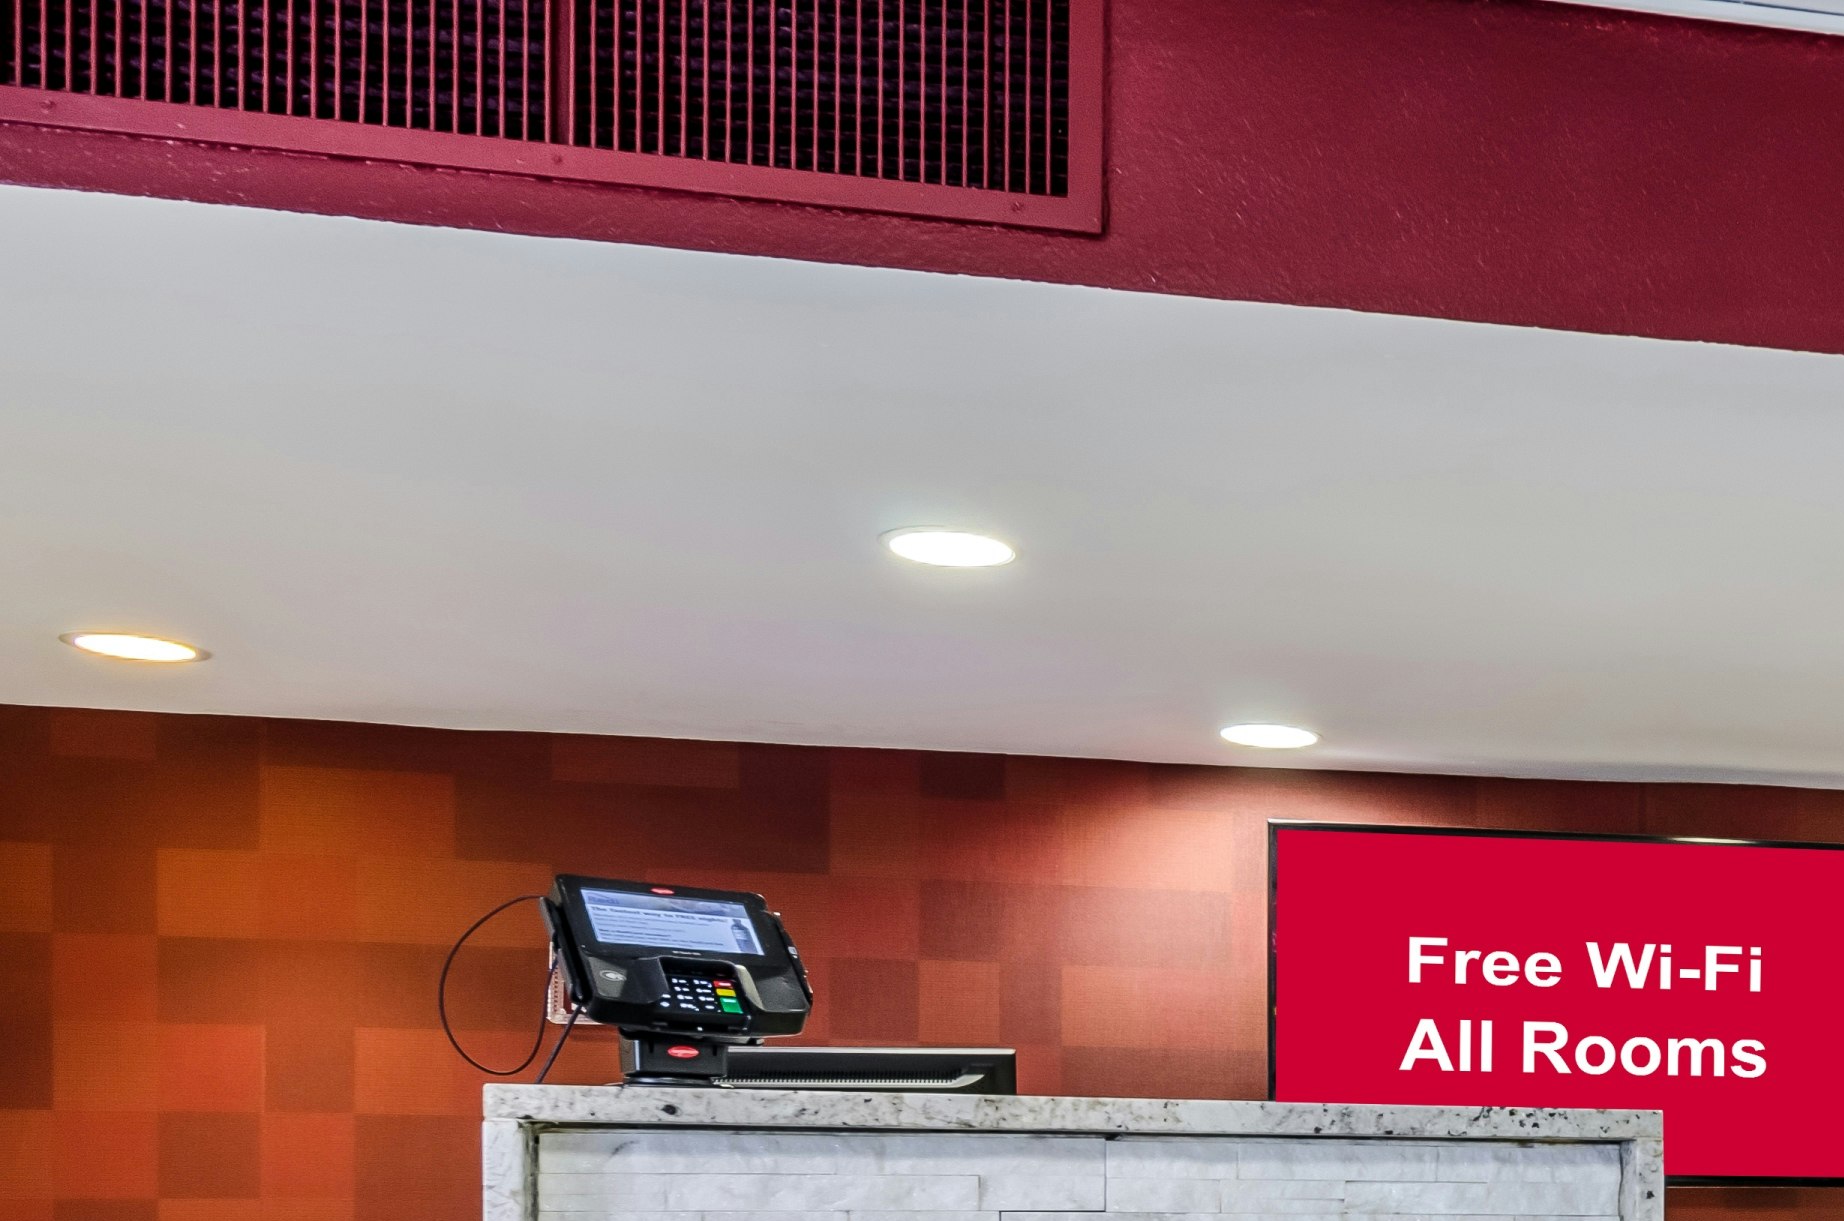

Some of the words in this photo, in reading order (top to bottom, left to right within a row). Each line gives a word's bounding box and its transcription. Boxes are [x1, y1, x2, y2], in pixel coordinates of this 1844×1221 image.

[1408, 936, 1563, 988] Free
[1585, 941, 1762, 993] Wi-Fi
[1398, 1018, 1493, 1073] All
[1522, 1020, 1767, 1079] Rooms
